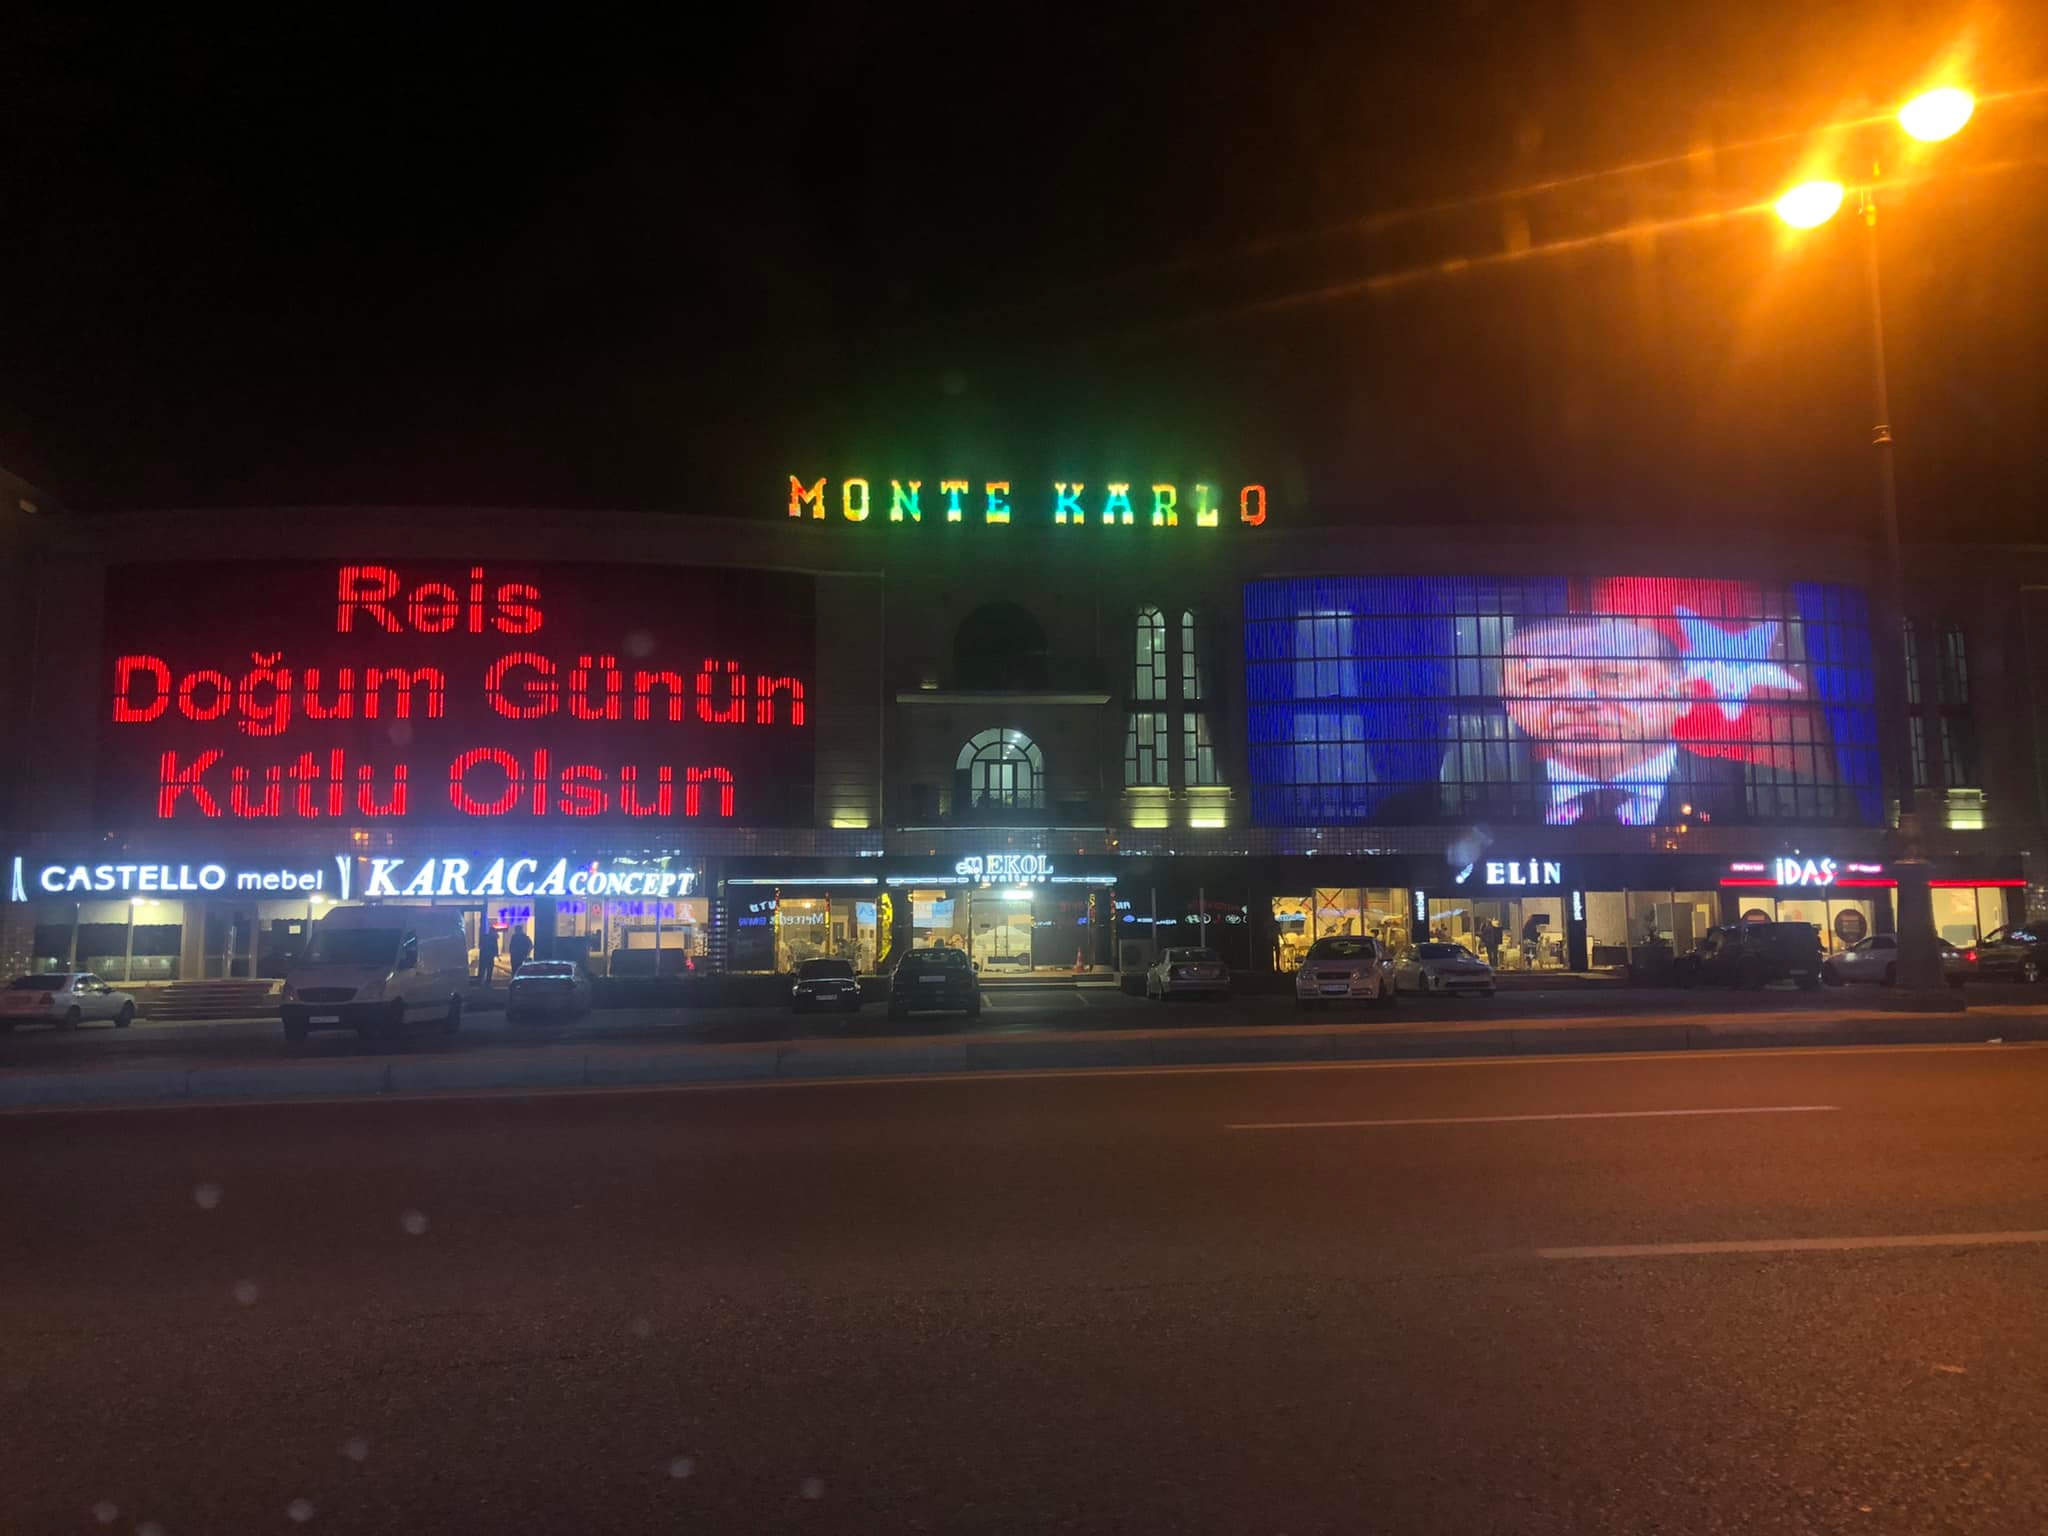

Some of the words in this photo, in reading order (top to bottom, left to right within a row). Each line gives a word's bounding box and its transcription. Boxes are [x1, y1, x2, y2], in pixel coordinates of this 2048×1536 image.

[788, 475, 1011, 524] MONTE
[1054, 481, 1267, 527] KARLO
[337, 565, 543, 633] Reis
[112, 650, 446, 736] Doğum
[484, 651, 806, 726] Günün
[157, 747, 409, 819] Kutlu
[448, 747, 735, 817] Olsun
[41, 865, 226, 892] CASTELLO
[237, 870, 323, 890] mebel
[364, 857, 568, 896] KARACA
[568, 870, 695, 897] CONCEPT
[986, 854, 1054, 875] EKOL
